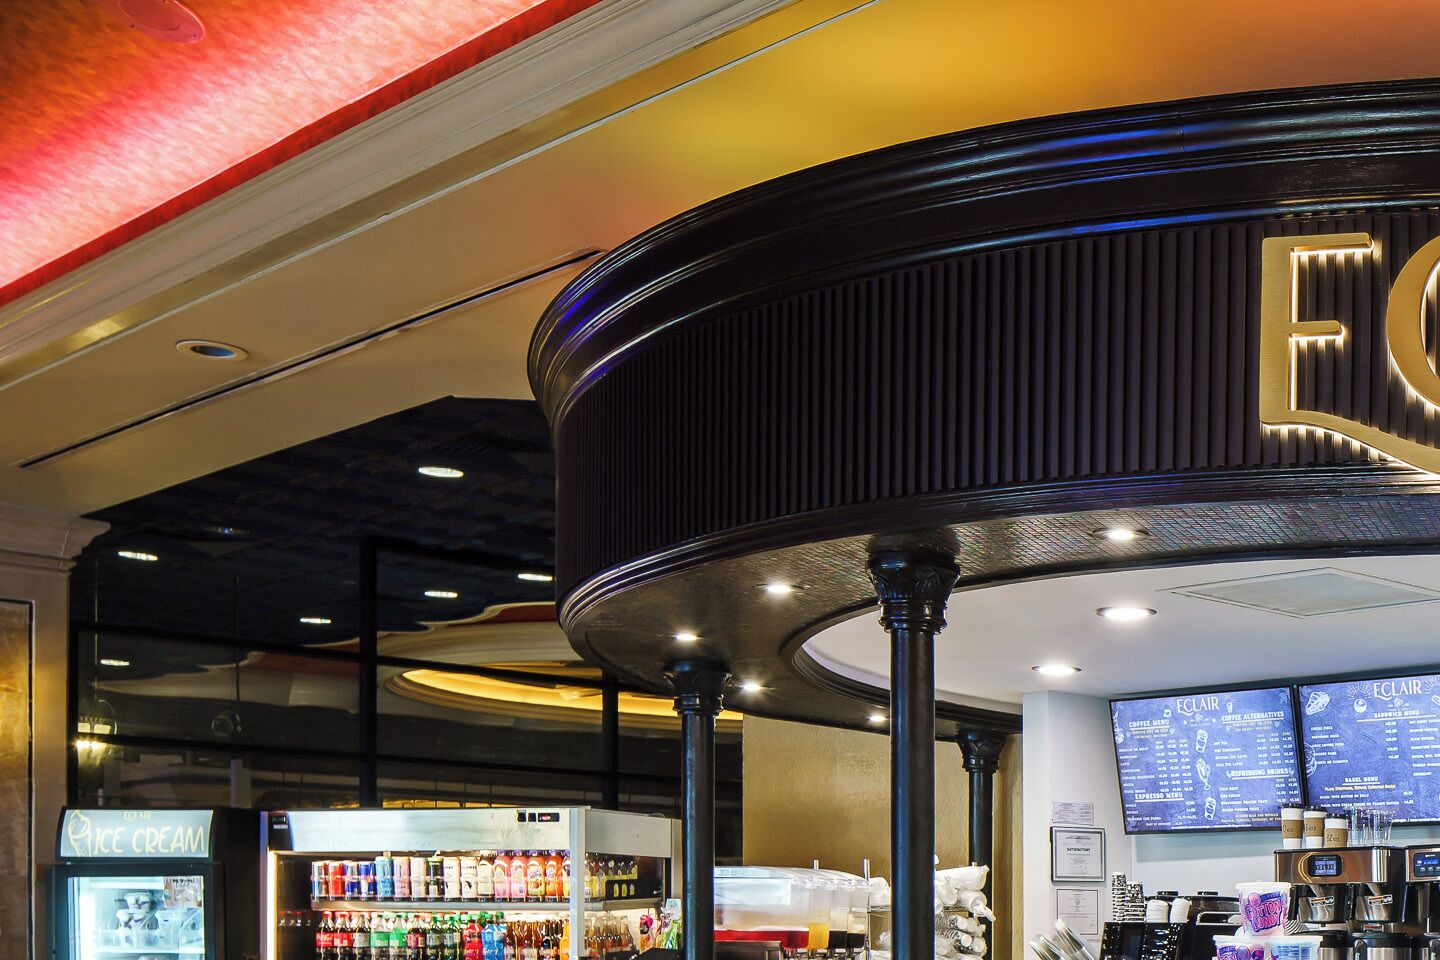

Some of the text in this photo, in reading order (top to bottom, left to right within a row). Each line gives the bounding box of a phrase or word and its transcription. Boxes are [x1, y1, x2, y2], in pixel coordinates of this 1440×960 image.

[1373, 680, 1422, 700] ECLAIR
[1177, 697, 1219, 716] ECLAIR
[1243, 711, 1284, 720] ALTERNATIVES
[1129, 720, 1151, 728] COFFEE
[1231, 769, 1265, 777] REFRESHING
[95, 825, 204, 855] ICE CREAM
[1245, 900, 1281, 921] COTTON
